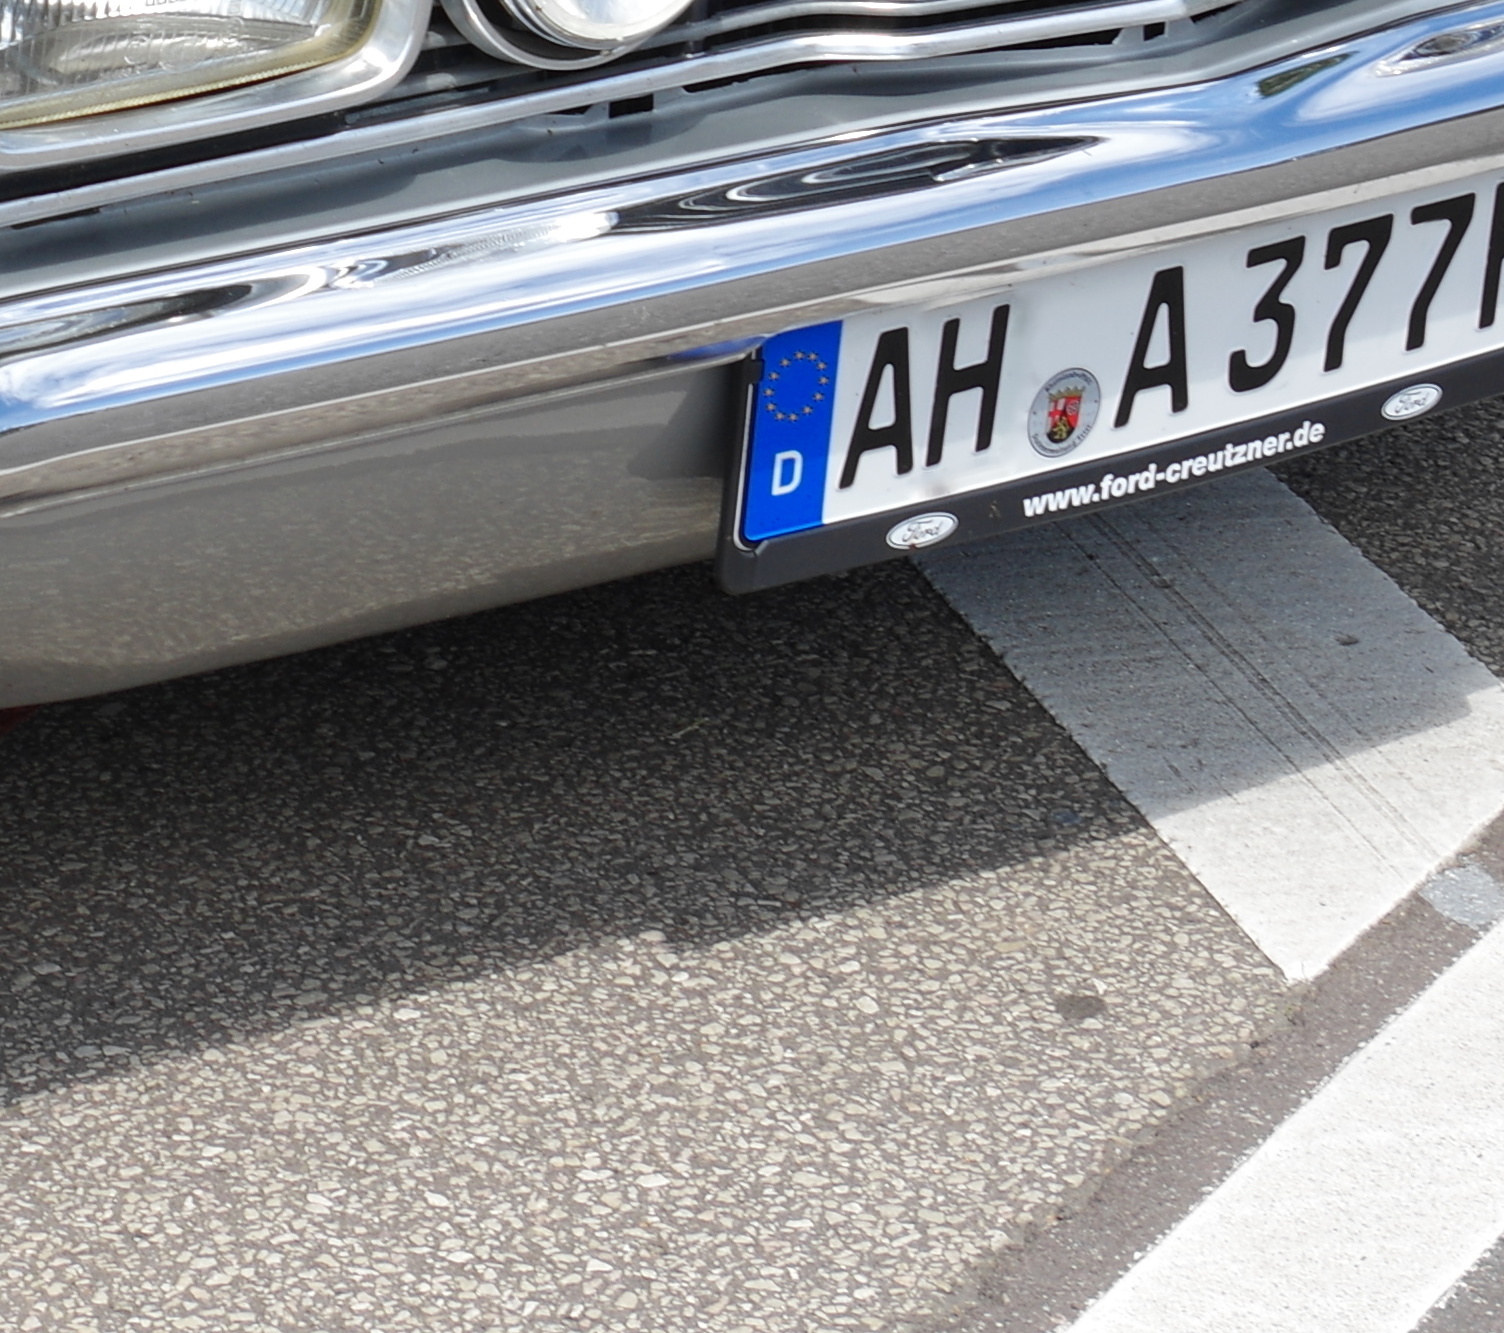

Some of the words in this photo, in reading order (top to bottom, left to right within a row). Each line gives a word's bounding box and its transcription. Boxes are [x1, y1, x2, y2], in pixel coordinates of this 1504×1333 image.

[838, 303, 1012, 490] AH
[1113, 265, 1187, 431] A
[771, 450, 804, 497] D
[1023, 421, 1326, 518] www.ford-creutzner.de
[901, 519, 943, 542] Ford
